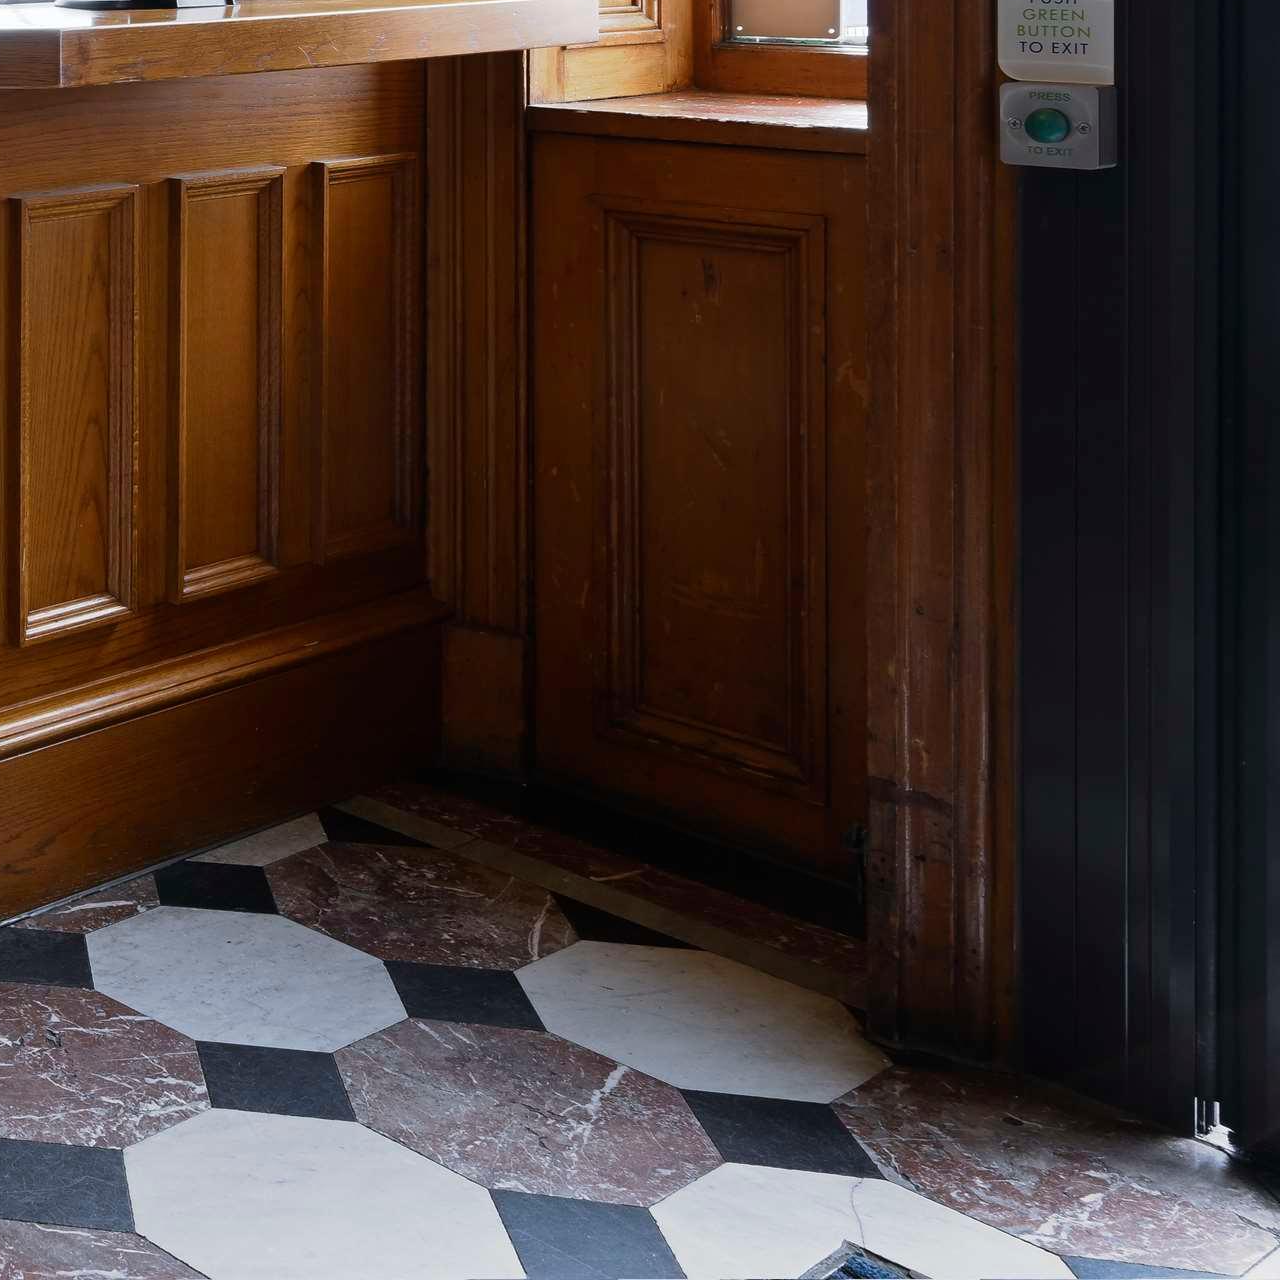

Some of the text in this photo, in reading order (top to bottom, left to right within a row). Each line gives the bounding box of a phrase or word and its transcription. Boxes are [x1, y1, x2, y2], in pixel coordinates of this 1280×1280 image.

[1022, 8, 1085, 21] GREEN
[1016, 24, 1091, 38] BUTTON
[1019, 41, 1089, 55] TO EXIT
[1028, 91, 1072, 103] PRESS
[1027, 146, 1074, 158] TO EXIT
